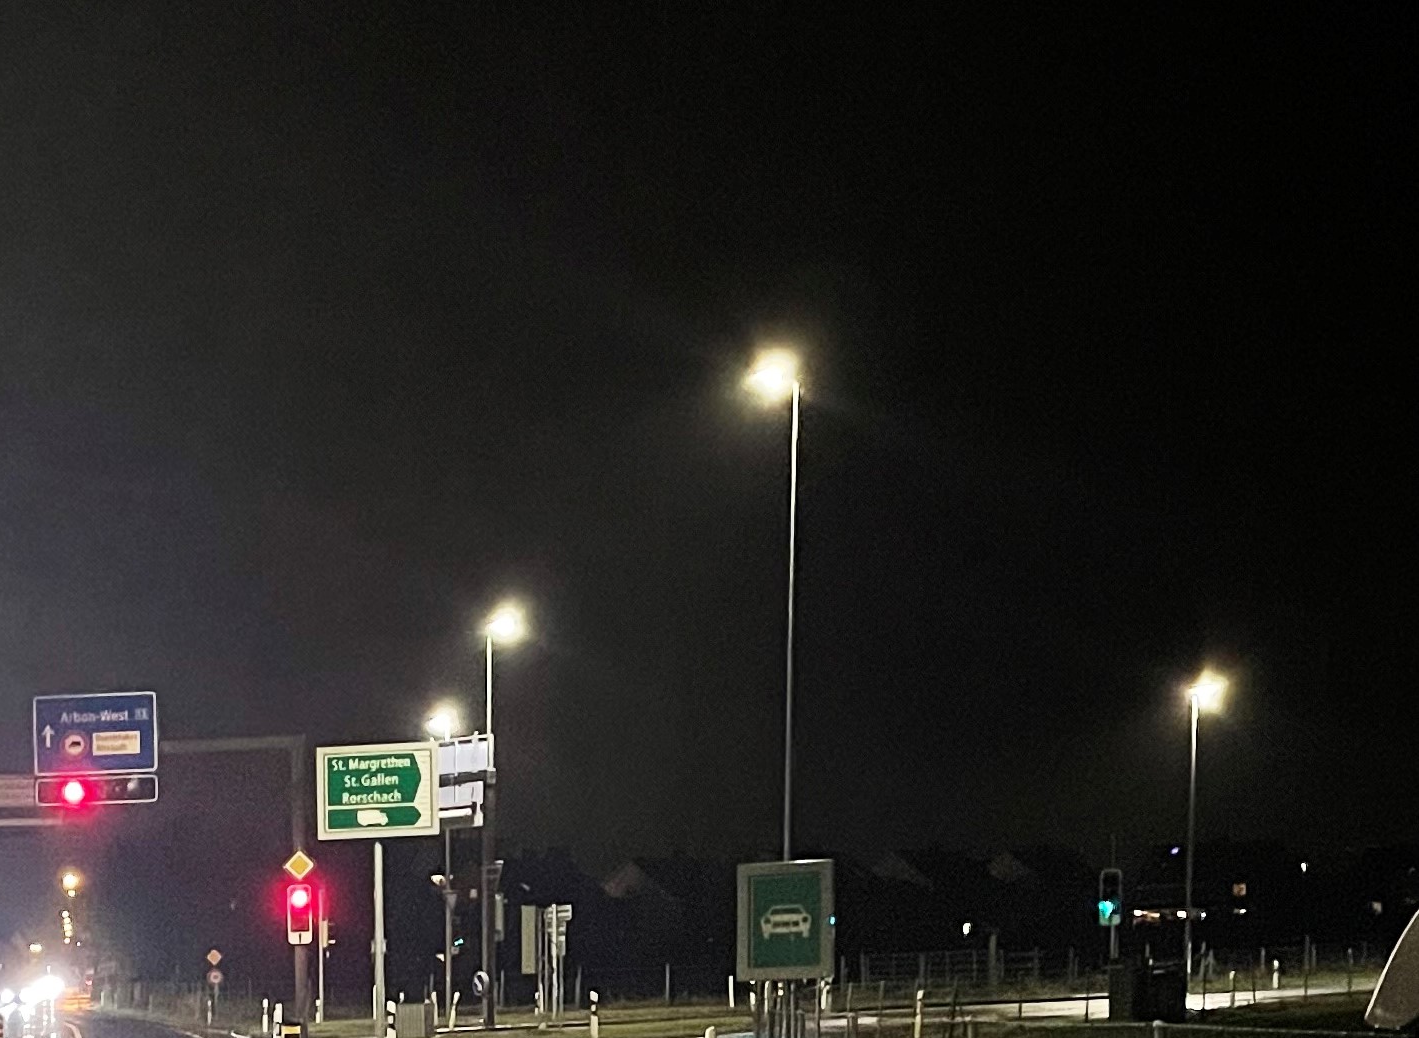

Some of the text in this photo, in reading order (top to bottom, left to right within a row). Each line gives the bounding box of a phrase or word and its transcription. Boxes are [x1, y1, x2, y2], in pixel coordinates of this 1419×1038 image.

[60, 710, 129, 724] Arbon-West
[331, 757, 411, 772] St. Margrethen
[344, 773, 399, 788] St. Gallen
[342, 789, 402, 805] Rorschach
